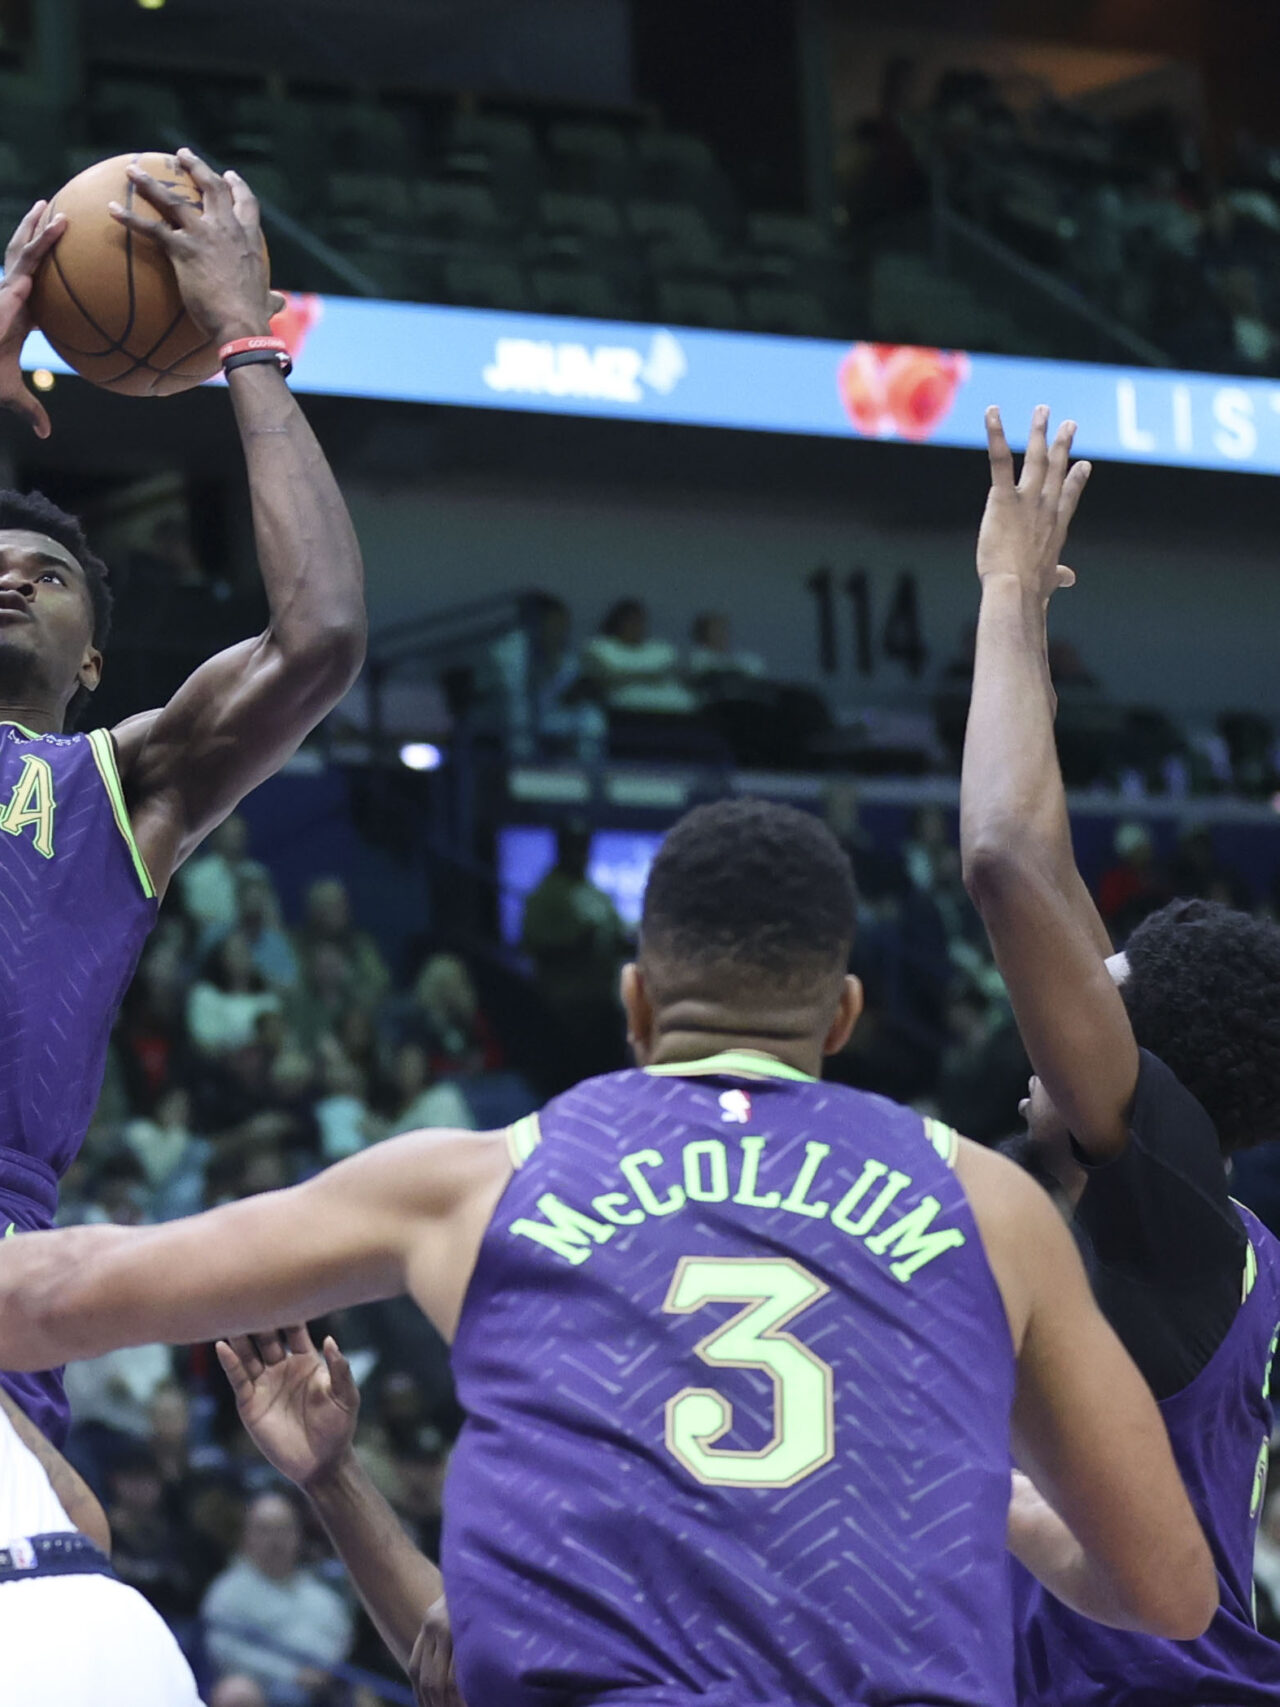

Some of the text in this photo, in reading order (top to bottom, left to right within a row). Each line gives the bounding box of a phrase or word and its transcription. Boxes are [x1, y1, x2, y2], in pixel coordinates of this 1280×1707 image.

[804, 566, 932, 677] 114
[509, 1135, 966, 1283] McCOLLUM
[662, 1256, 835, 1489] 3
